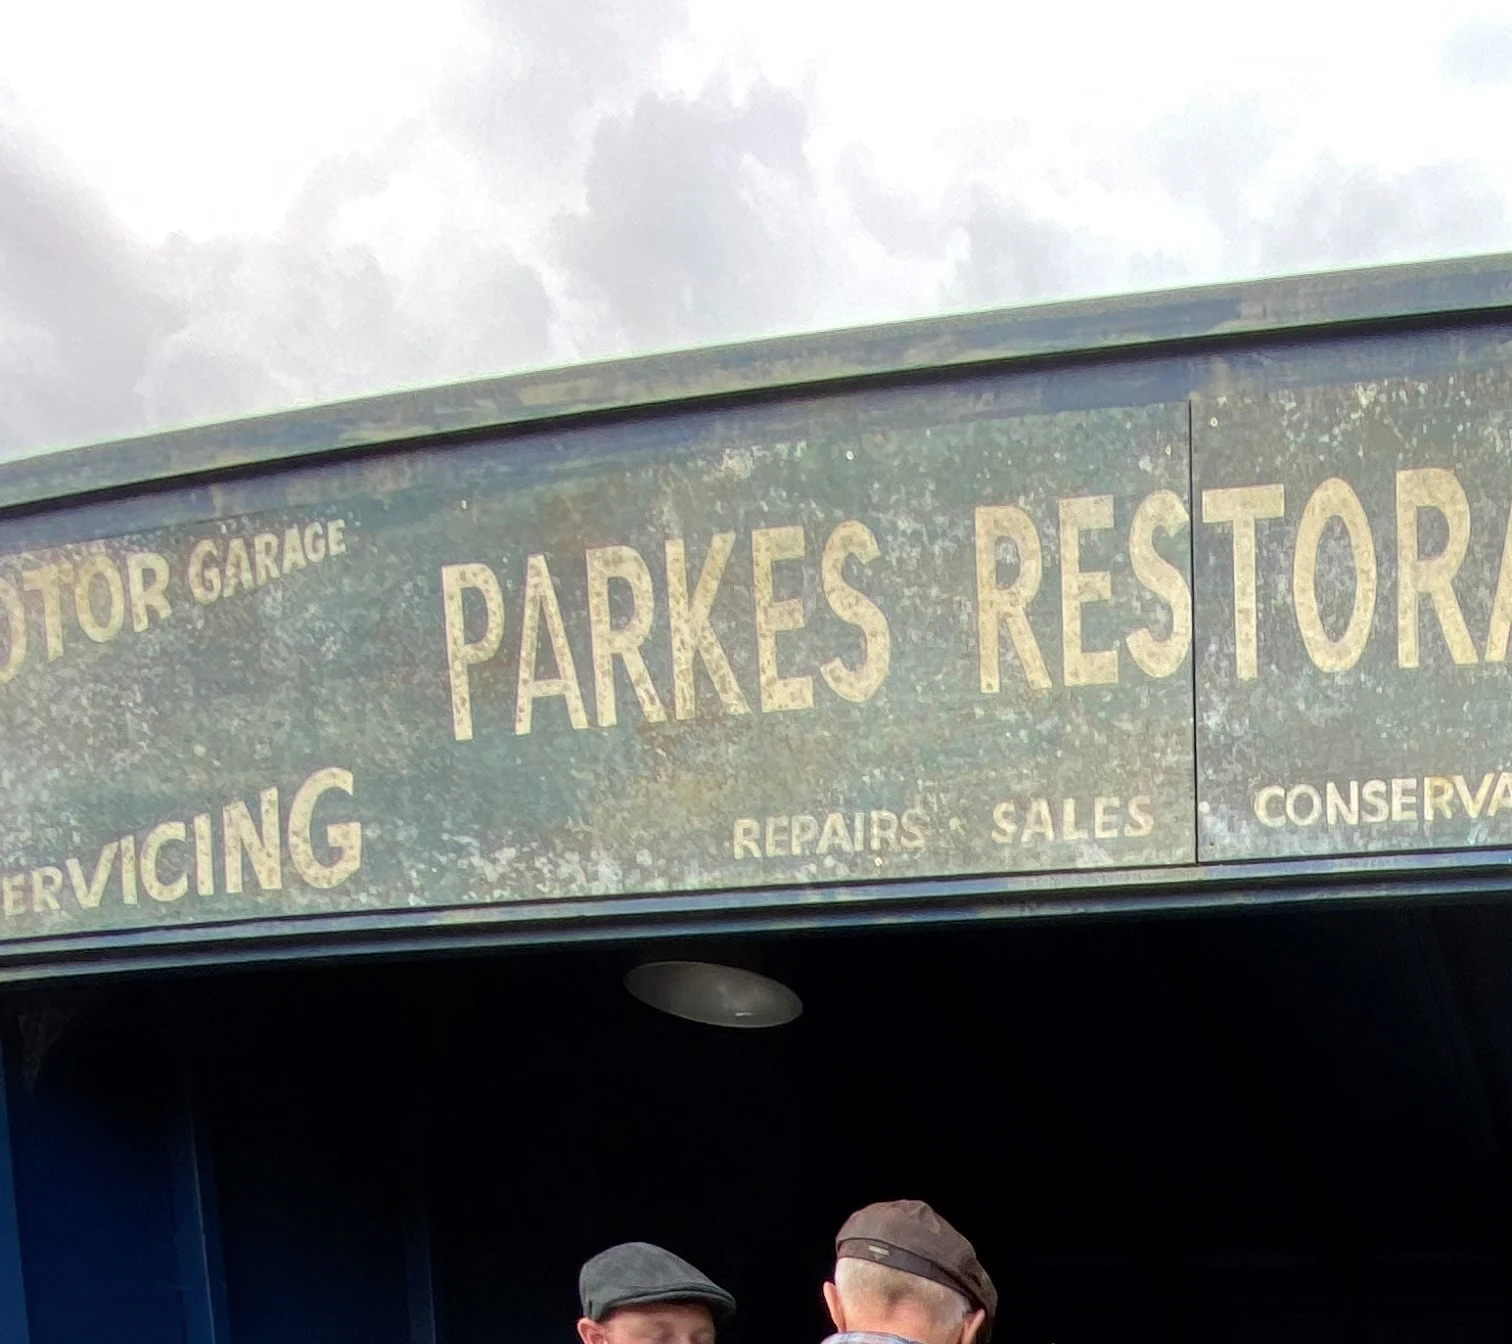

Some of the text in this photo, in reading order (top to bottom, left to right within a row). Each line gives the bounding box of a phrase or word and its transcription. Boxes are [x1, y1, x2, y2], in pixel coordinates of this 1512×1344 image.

[188, 519, 348, 605] GARAGE
[441, 519, 892, 741] PARKES
[733, 808, 928, 860] REPAIRS
[992, 795, 1154, 844] SALES
